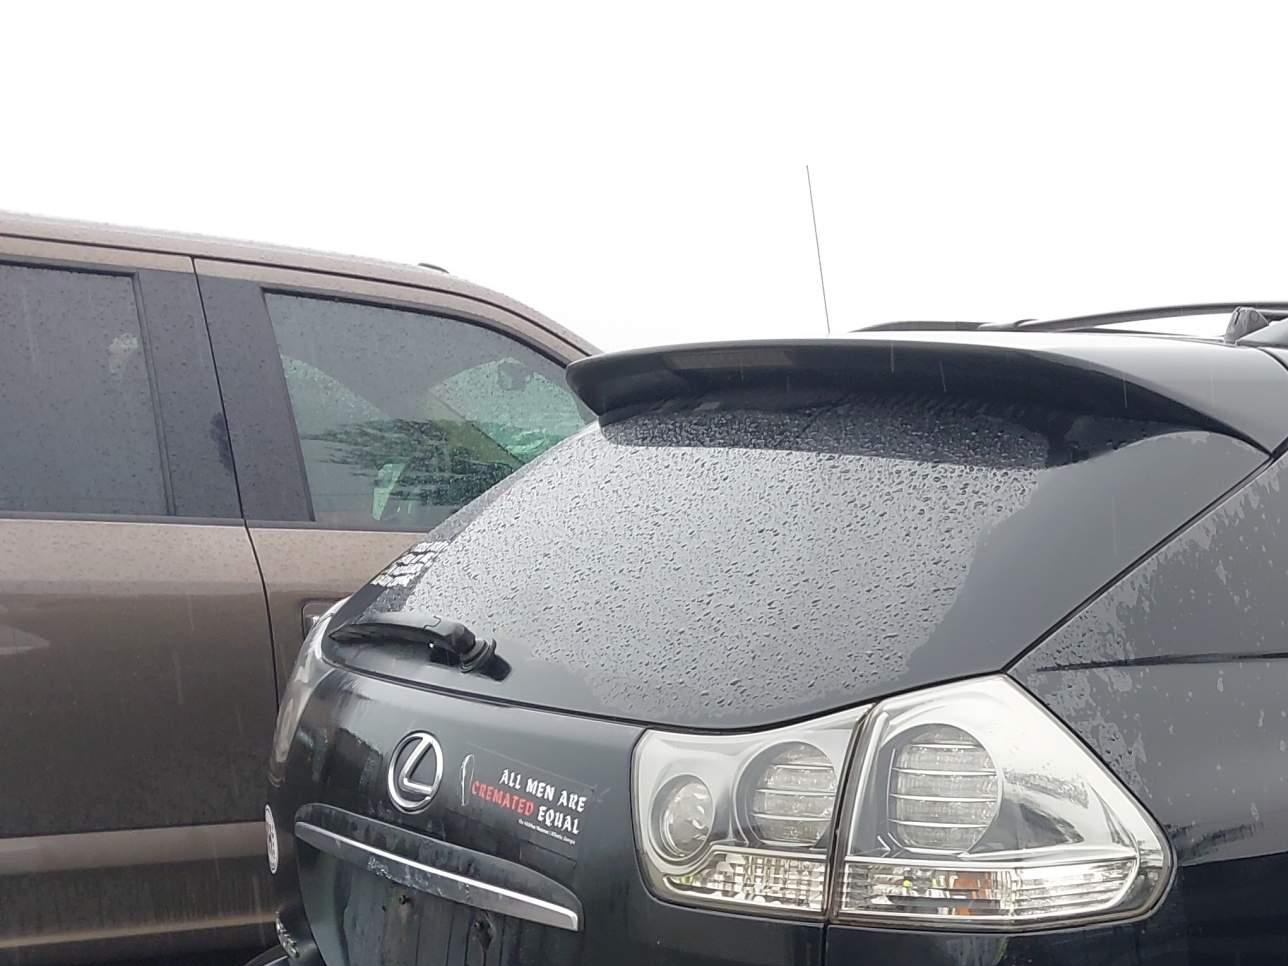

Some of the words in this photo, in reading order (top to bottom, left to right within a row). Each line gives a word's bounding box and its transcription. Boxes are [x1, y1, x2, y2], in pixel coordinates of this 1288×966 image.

[471, 780, 534, 816] CREMATED
[537, 806, 579, 834] EQUAL
[499, 769, 521, 790] ALL
[526, 778, 555, 801] MEN
[557, 790, 587, 812] ARE
